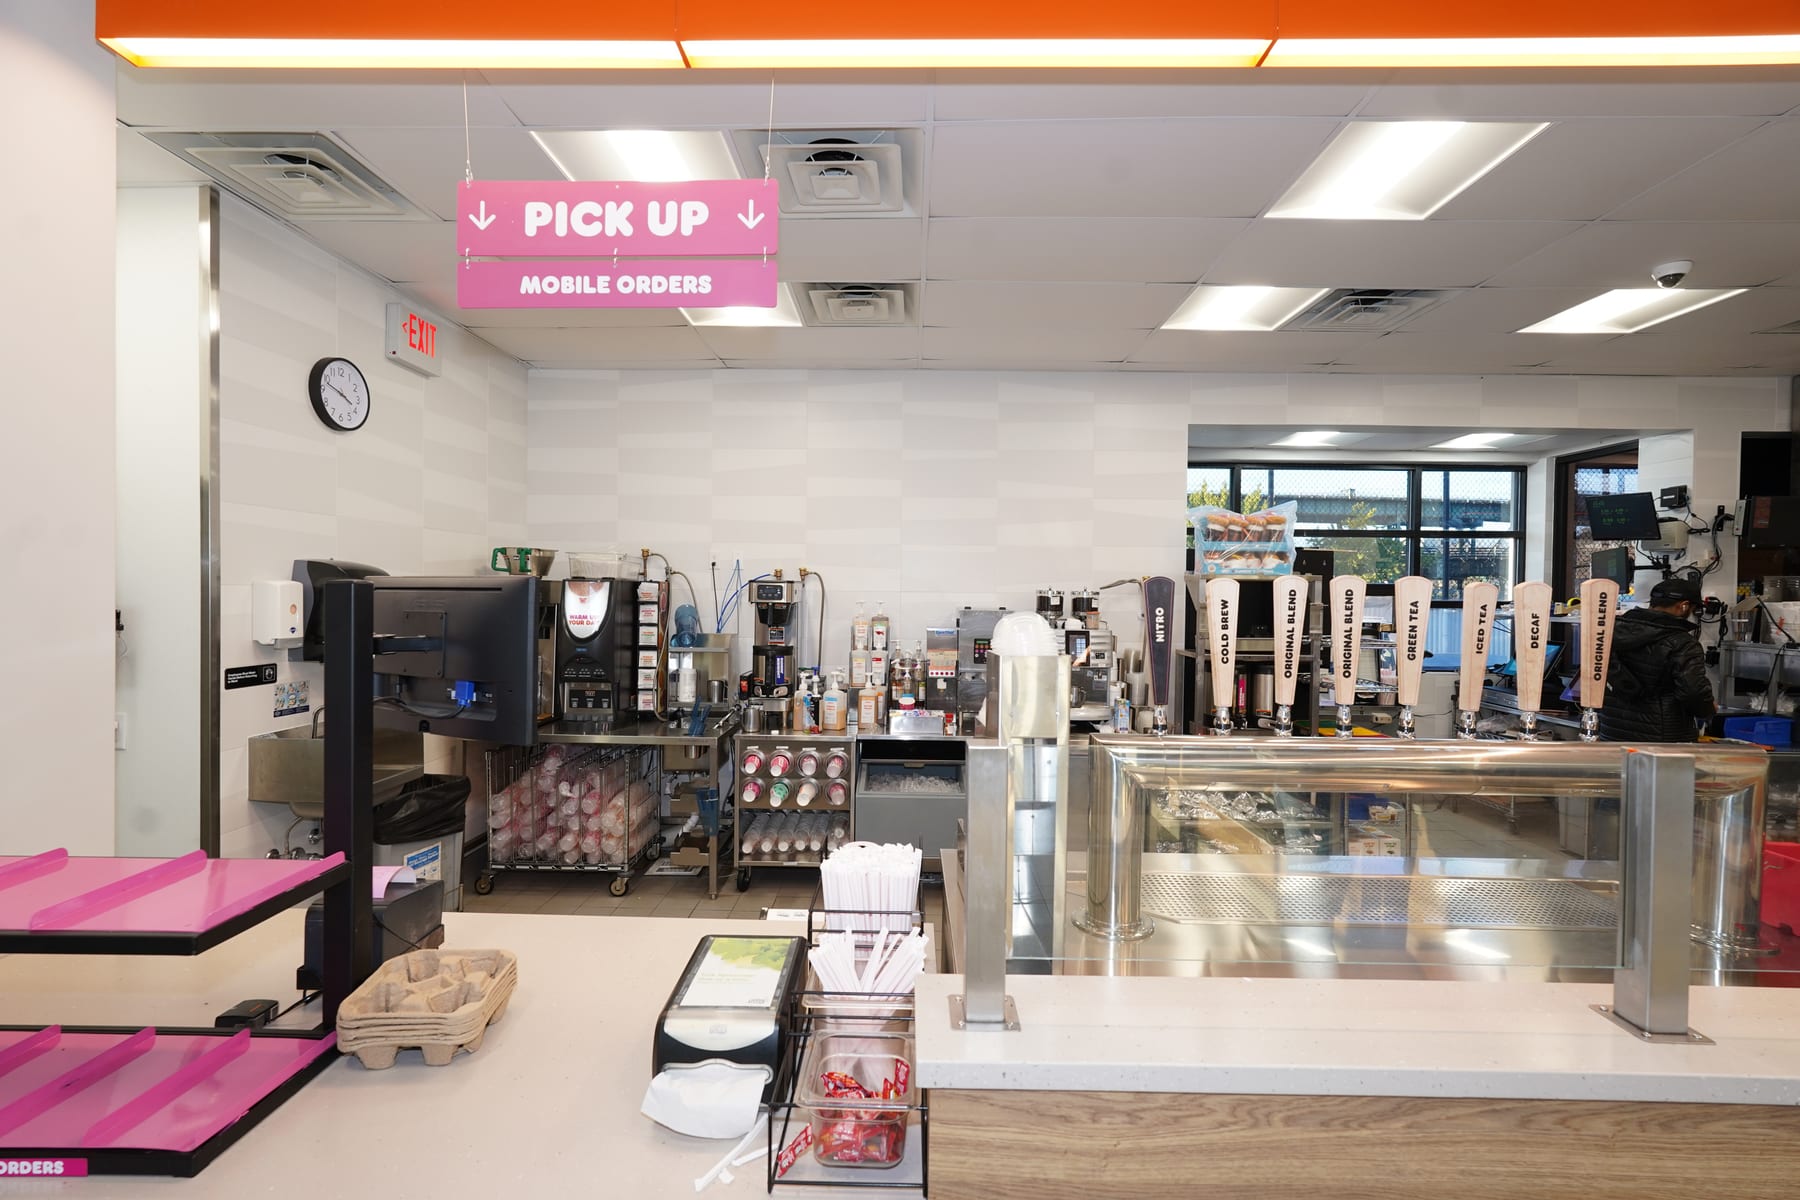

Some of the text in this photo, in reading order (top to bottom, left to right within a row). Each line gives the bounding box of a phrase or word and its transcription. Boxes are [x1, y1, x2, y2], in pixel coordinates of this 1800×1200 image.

[525, 201, 710, 237] PICK UP
[520, 275, 712, 294] MOBILE ORDERS
[409, 312, 437, 359] EXIT
[337, 367, 345, 378] 12
[353, 383, 358, 392] 2
[339, 413, 343, 422] 6
[1155, 607, 1165, 643] NITRO
[1220, 599, 1230, 665] COLD BREW
[1284, 589, 1297, 679] ORIGINAL BLEND
[1343, 589, 1354, 679] ORIGINAL BLEND
[1407, 600, 1420, 661] GREEN TEA
[1476, 604, 1488, 654] ICED TEA
[1531, 613, 1540, 649] DECAF
[1594, 591, 1608, 681] ORIGINAL BLEND
